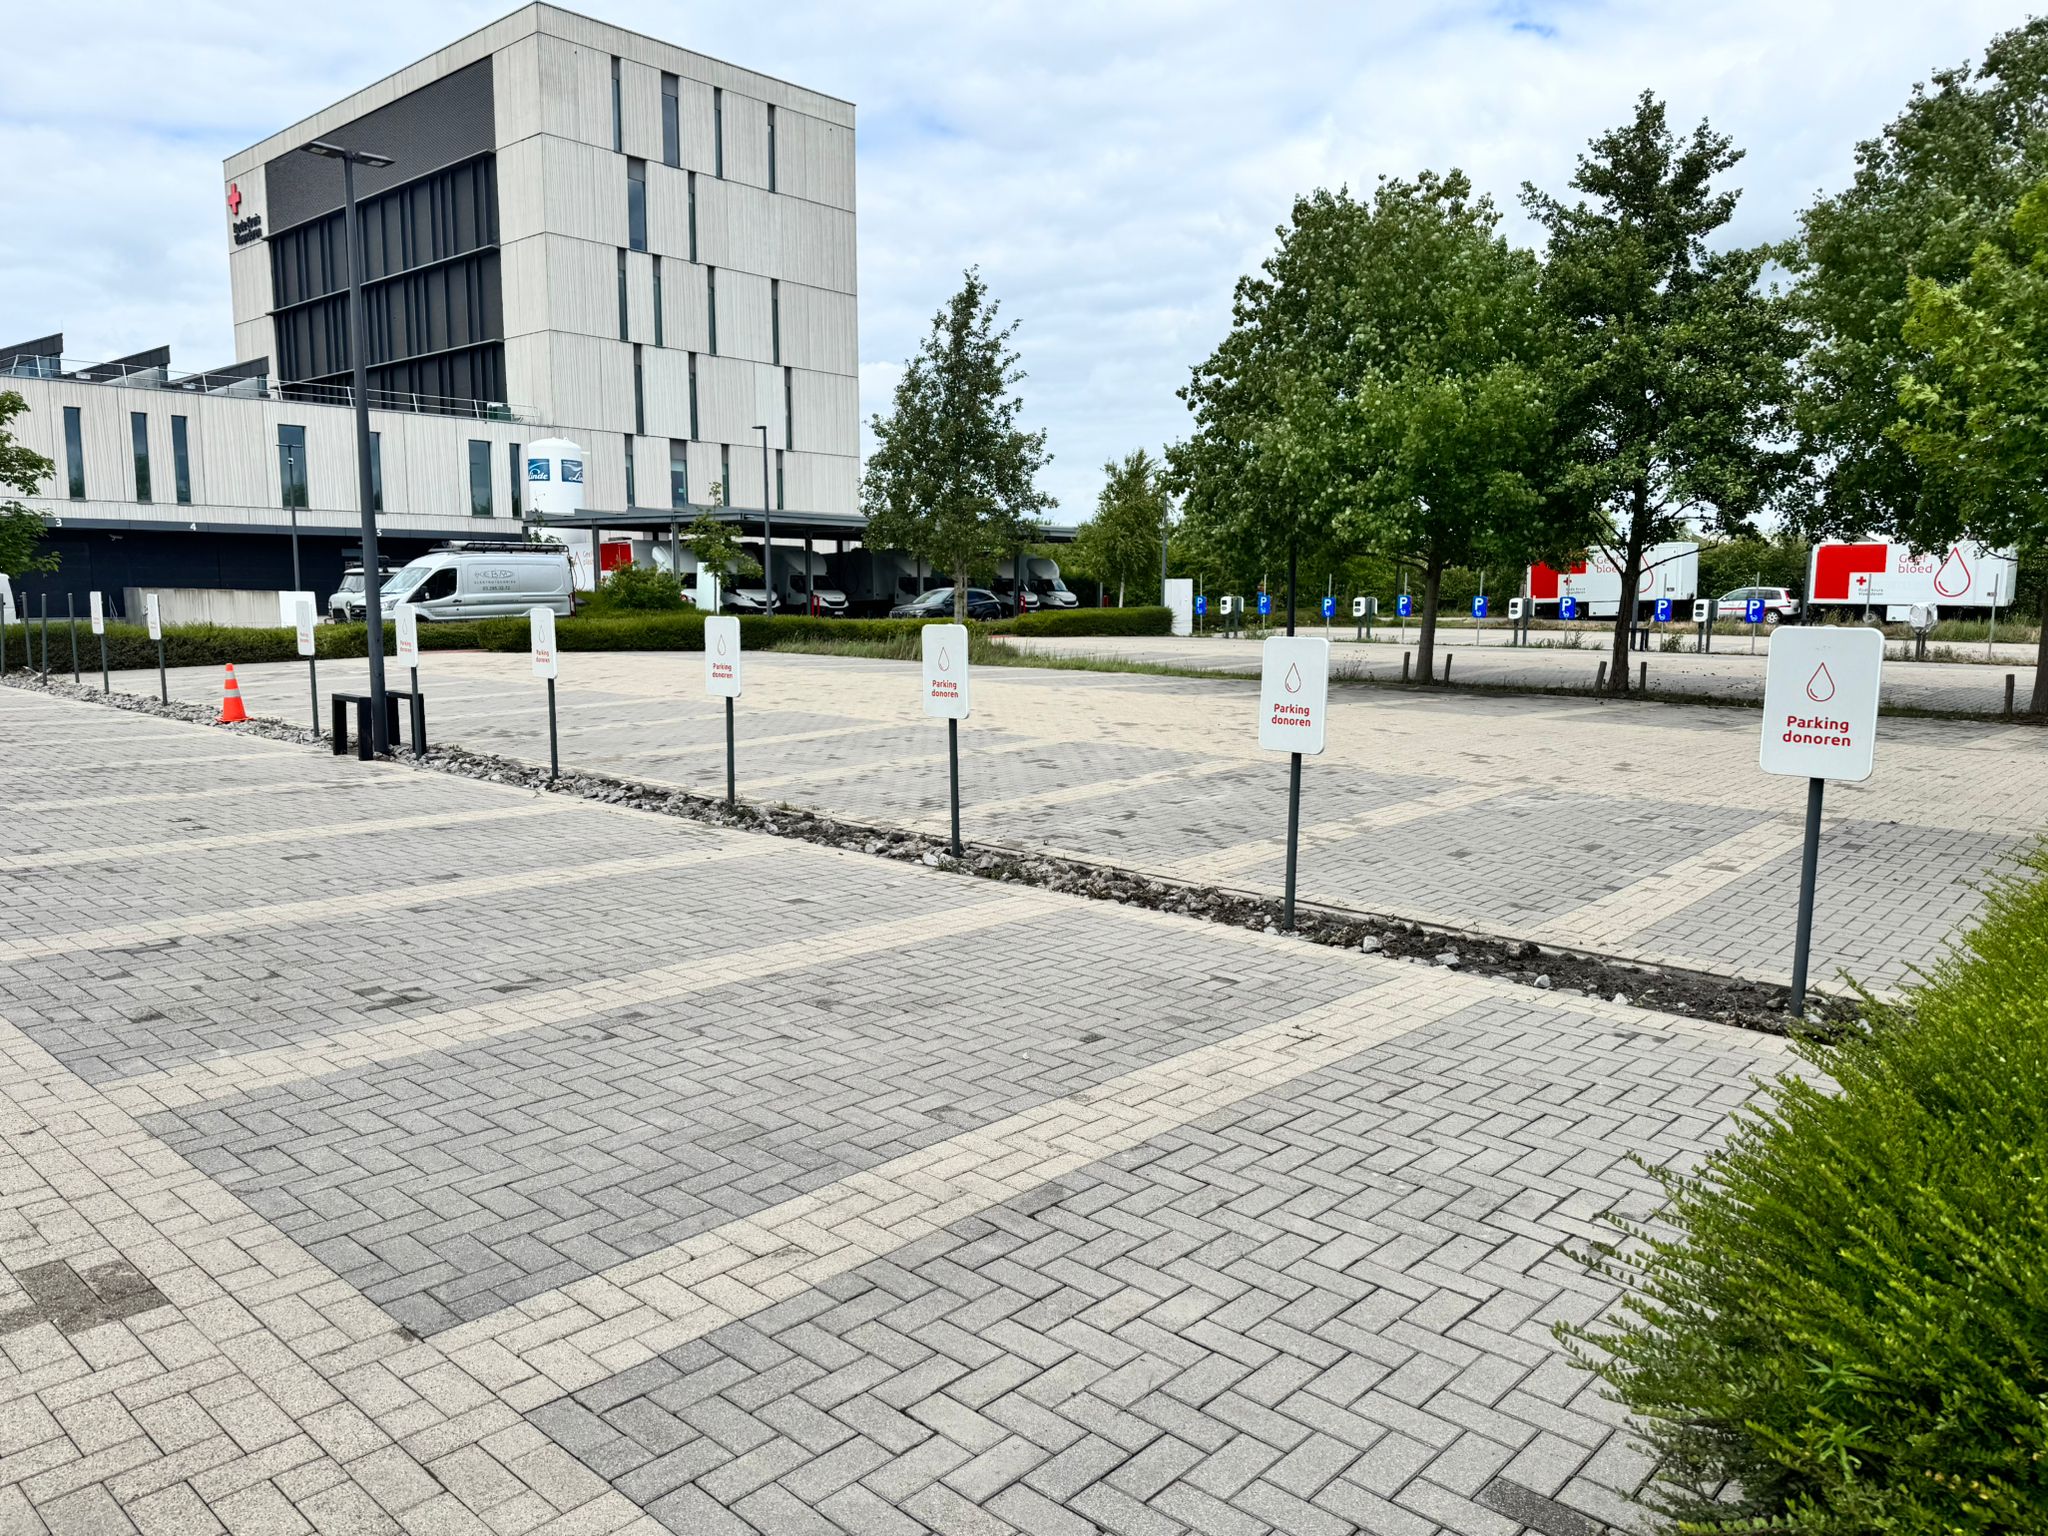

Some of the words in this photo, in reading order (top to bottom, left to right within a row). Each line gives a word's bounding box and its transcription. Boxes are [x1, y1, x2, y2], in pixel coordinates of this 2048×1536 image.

[55, 518, 63, 527] 3
[189, 522, 197, 531] 4
[376, 528, 382, 537] 5
[1597, 554, 1620, 564] Gef
[1898, 563, 1932, 573] bloed
[1197, 597, 1203, 607] P
[1260, 596, 1267, 606] P
[1324, 599, 1332, 610] P
[1400, 597, 1408, 609] P
[1475, 598, 1484, 610] P
[1562, 598, 1571, 611] P
[1657, 600, 1667, 613] P
[1749, 600, 1760, 614] P
[932, 679, 957, 690] Parking
[931, 689, 959, 698] donoren
[1273, 703, 1310, 717] Parking
[1271, 714, 1311, 727] donoren
[1787, 715, 1849, 733] Parking
[1782, 730, 1851, 747] donoren
